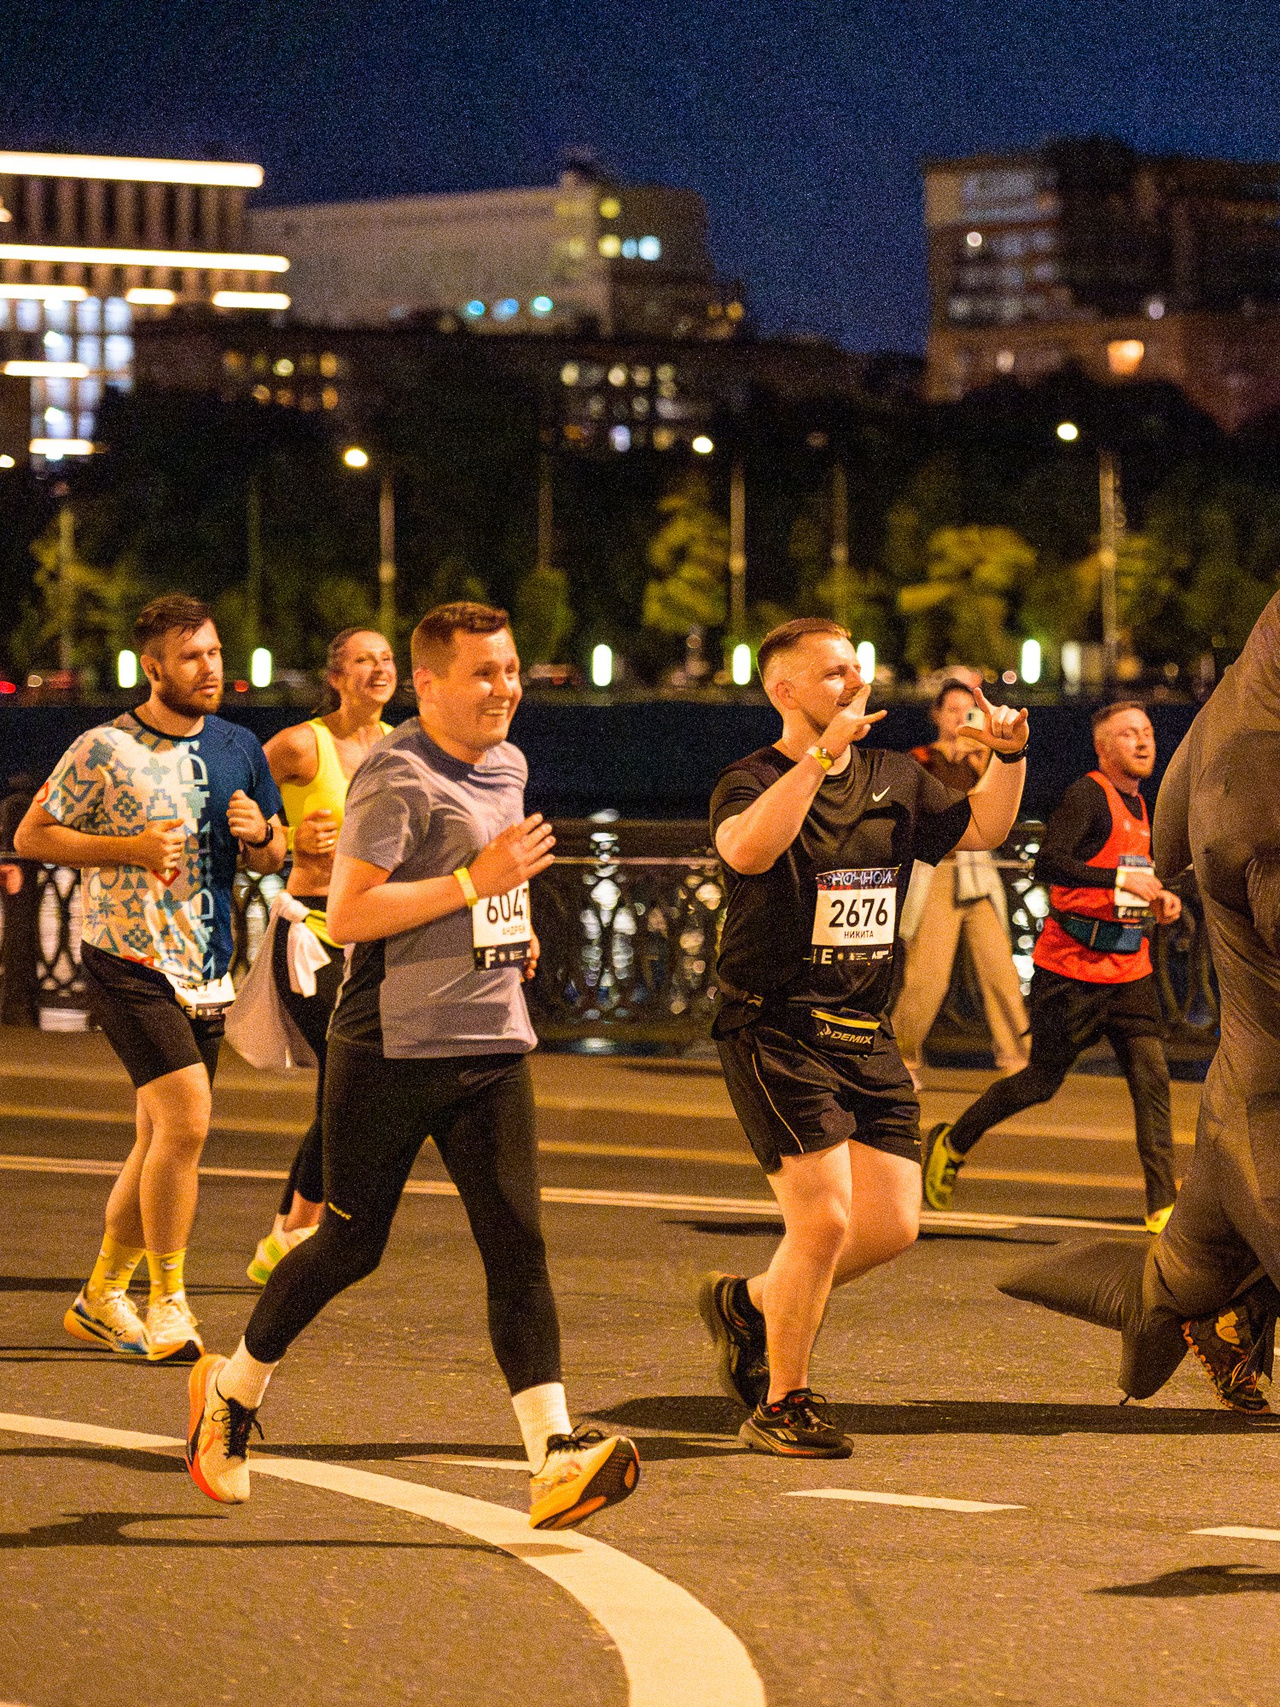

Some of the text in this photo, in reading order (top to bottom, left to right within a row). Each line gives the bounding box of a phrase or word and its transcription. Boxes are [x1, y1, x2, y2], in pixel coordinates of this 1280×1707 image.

[828, 897, 888, 928] 2676
[843, 930, 875, 939] НИКИТА
[830, 1030, 874, 1045] DEMIX
